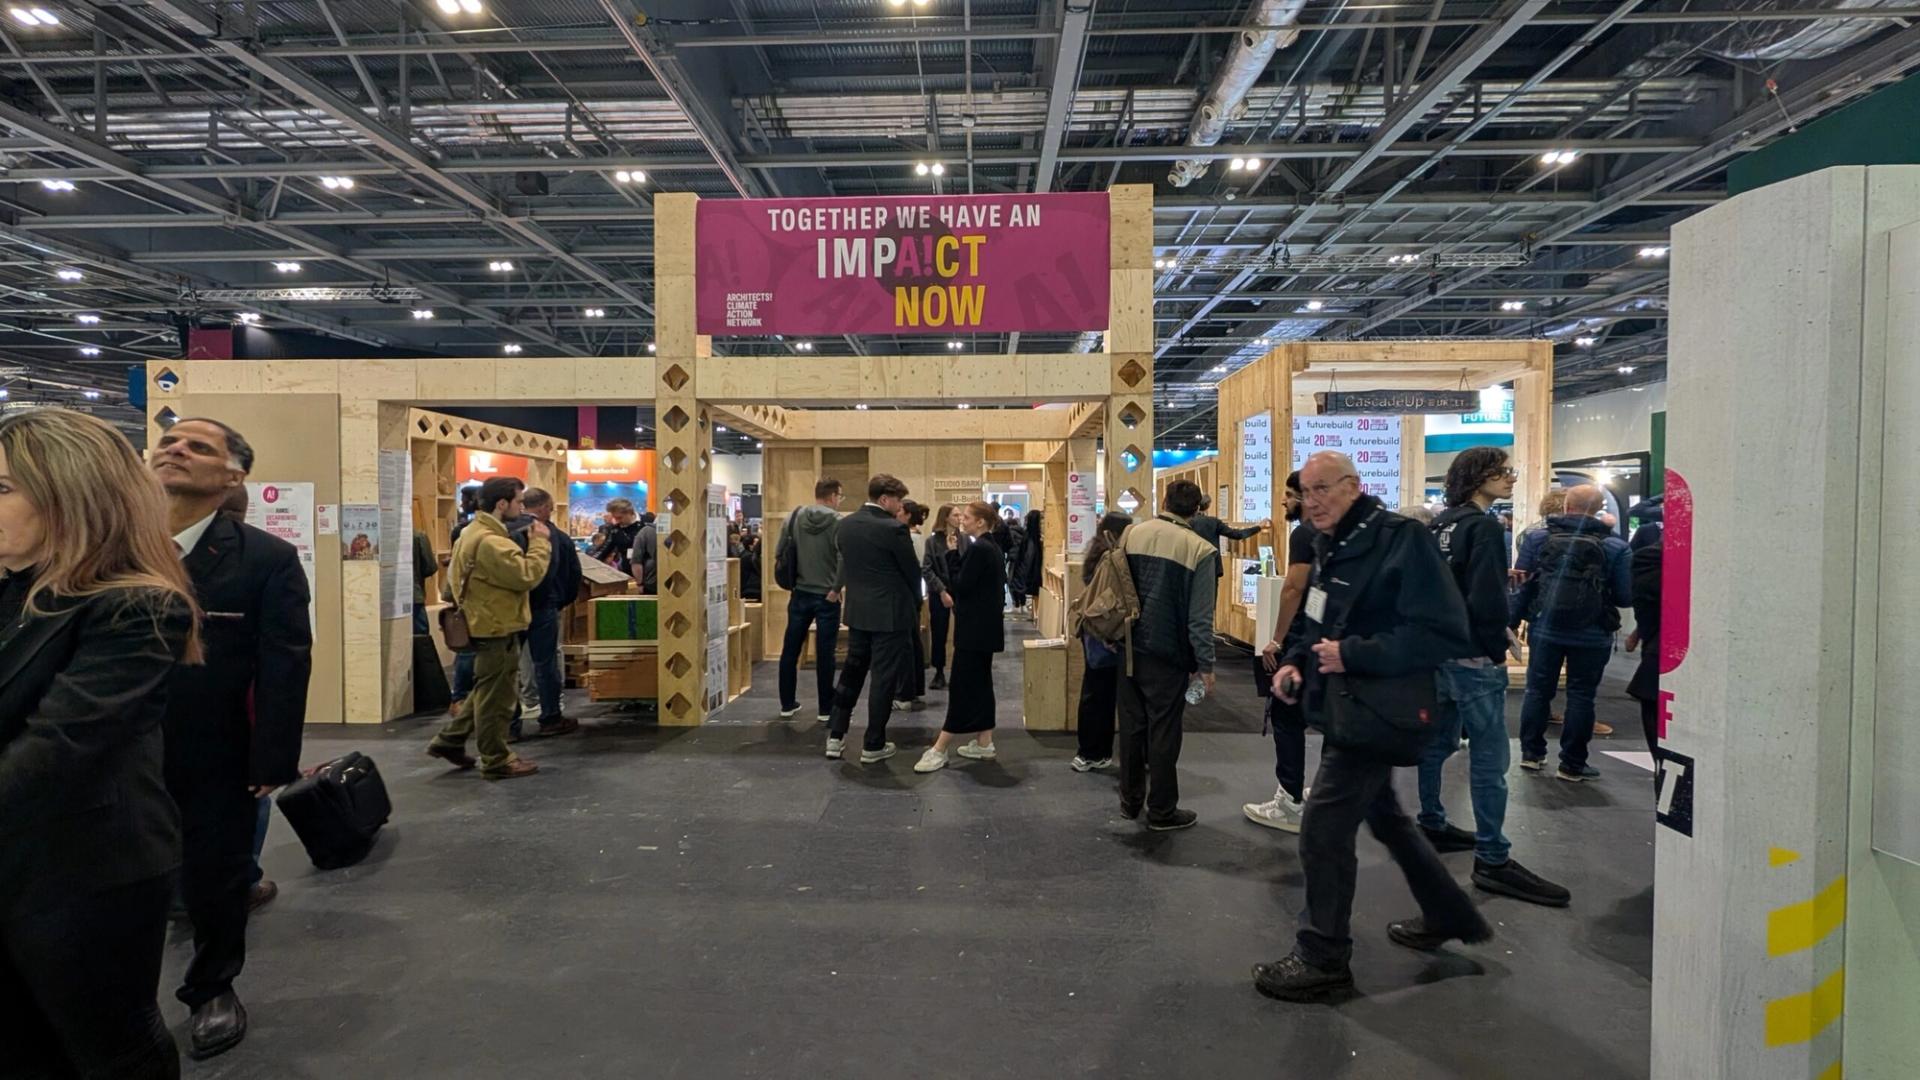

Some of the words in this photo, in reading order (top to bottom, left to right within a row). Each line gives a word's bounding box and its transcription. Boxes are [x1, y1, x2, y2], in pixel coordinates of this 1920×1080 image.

[767, 206, 888, 231] TOGETHER
[896, 205, 931, 229] WE
[939, 204, 1001, 228] HAVE
[1009, 203, 1041, 227] AN
[817, 235, 987, 279] IMPA!CT
[726, 293, 773, 301] ARCHITECTS!
[726, 301, 758, 310] CLIMATE
[895, 284, 986, 327] NOW
[726, 310, 753, 318] ACTION
[726, 318, 762, 327] NETWORK
[1345, 394, 1424, 409] CascadeUp
[1306, 419, 1353, 429] futurebuild
[1357, 418, 1369, 431] 20
[1314, 434, 1325, 447] 20
[1349, 436, 1399, 446] futurebuild
[1357, 451, 1369, 463] 20
[469, 455, 498, 473] NL
[1359, 468, 1399, 478] turebuild
[962, 480, 980, 488] BARK
